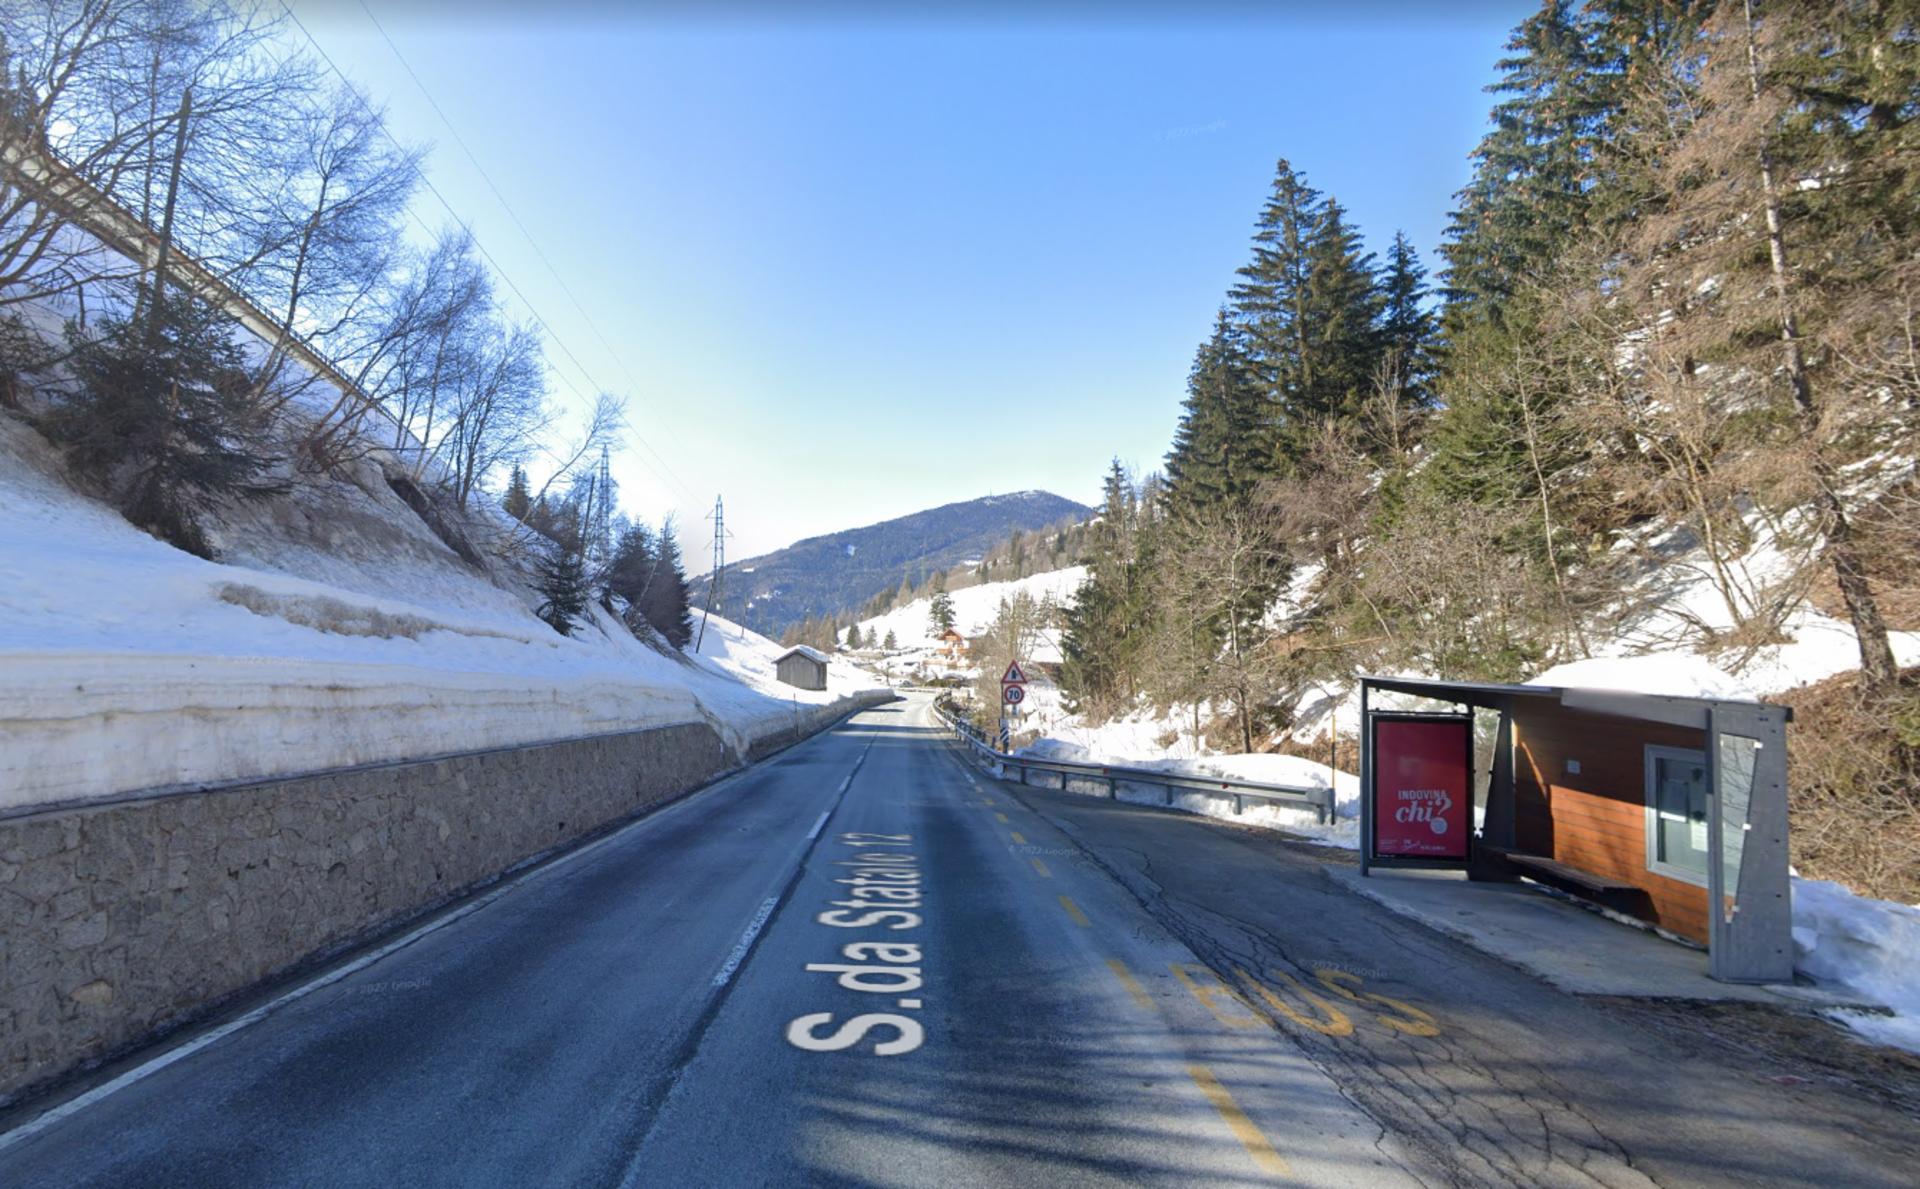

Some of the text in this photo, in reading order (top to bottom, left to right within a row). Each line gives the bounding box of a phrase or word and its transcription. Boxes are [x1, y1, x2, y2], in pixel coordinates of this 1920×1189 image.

[1008, 690, 1020, 700] 70
[1398, 789, 1448, 800] INDOVINA
[1168, 963, 1441, 1037] BUS
